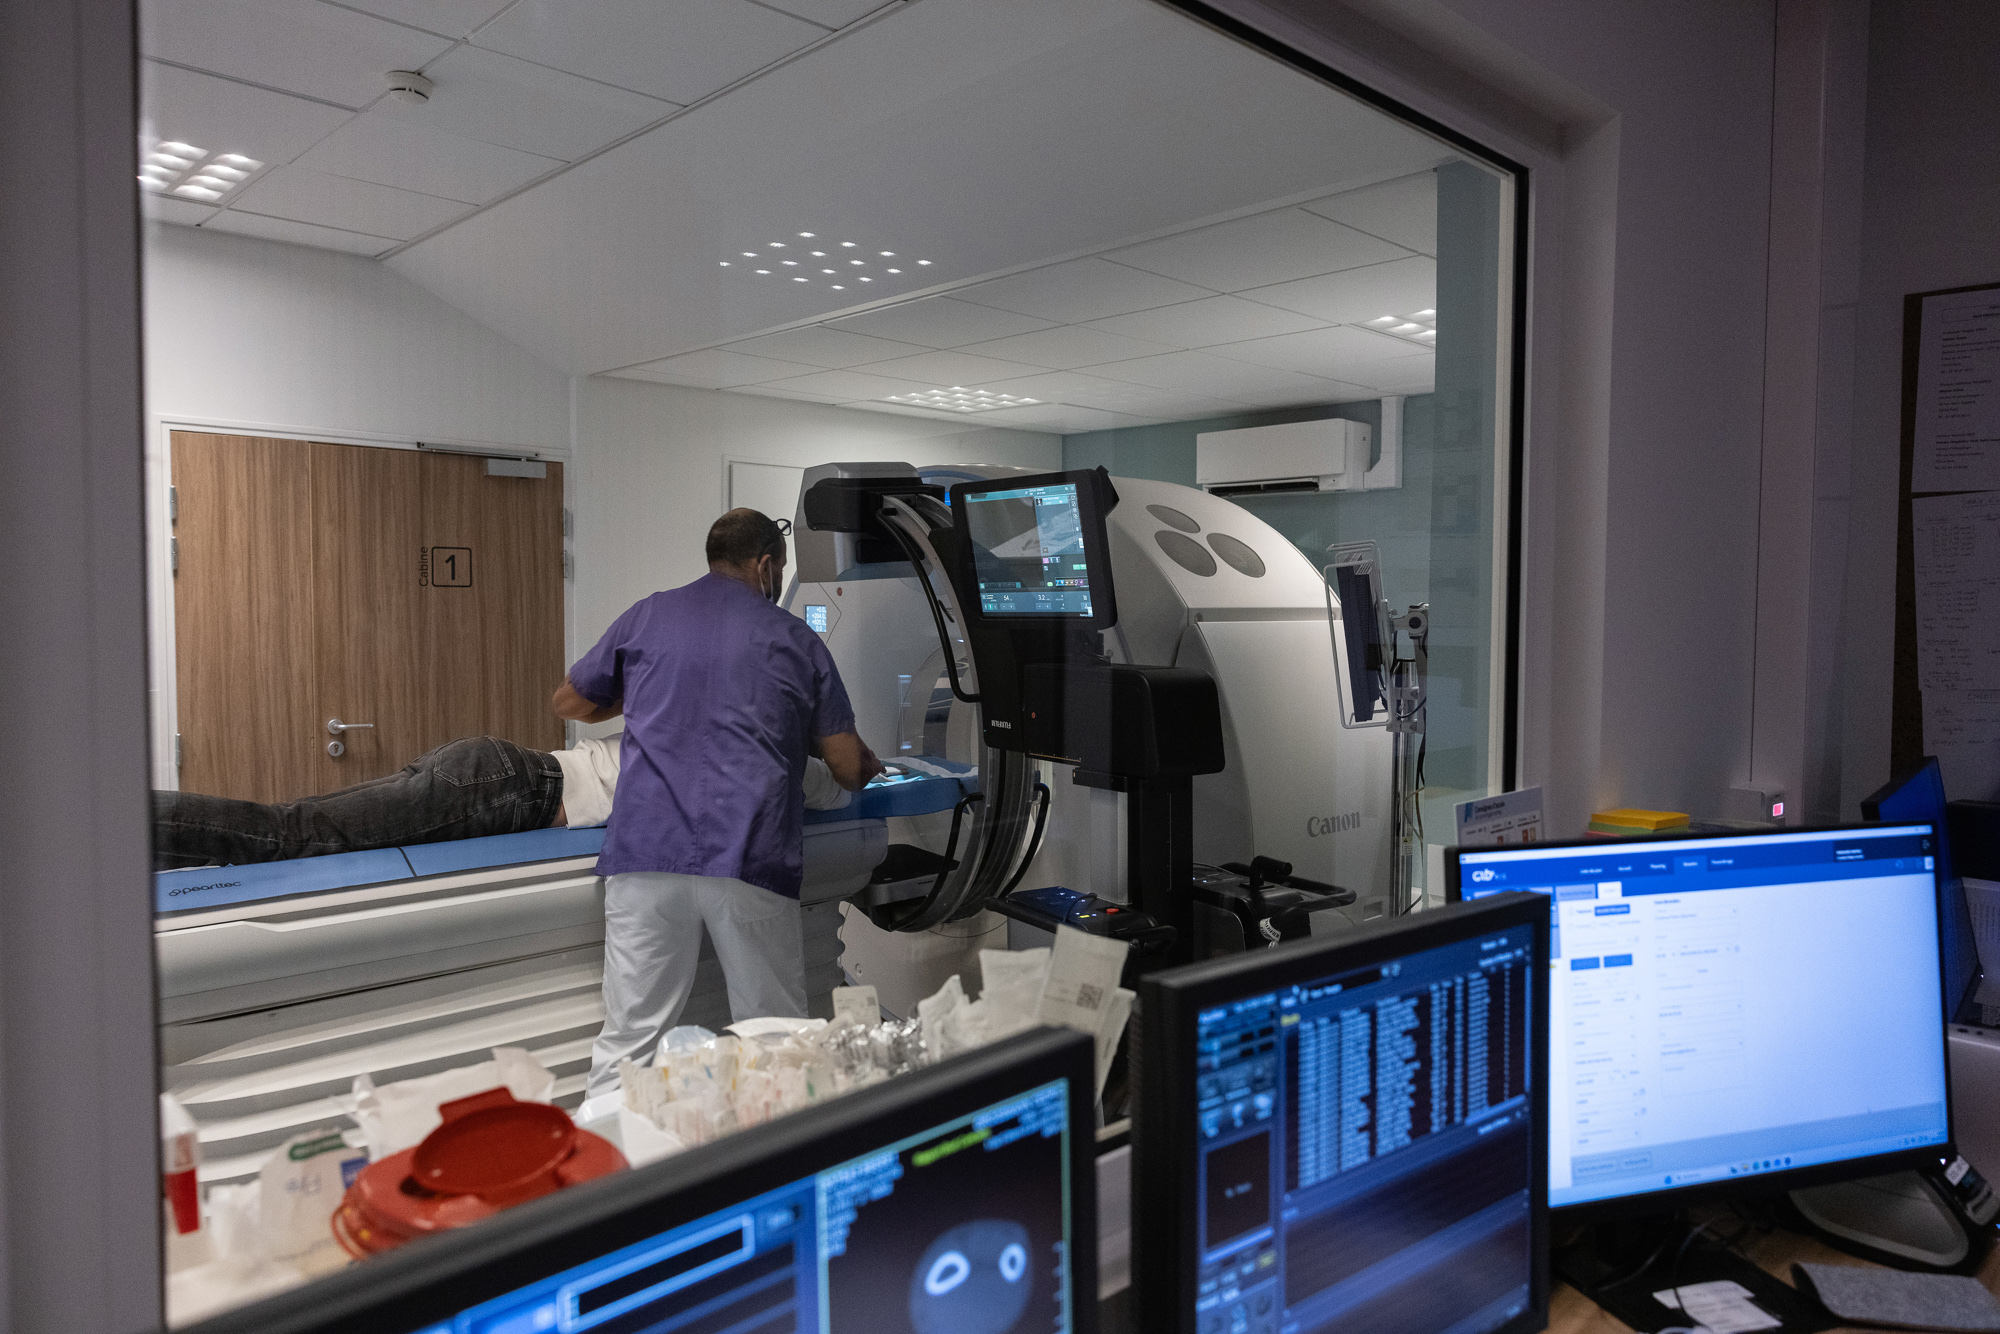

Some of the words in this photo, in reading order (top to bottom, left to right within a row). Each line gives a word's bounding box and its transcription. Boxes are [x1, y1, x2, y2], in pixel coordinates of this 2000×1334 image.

[418, 546, 429, 587] Cabine
[444, 554, 456, 581] 1
[991, 719, 1012, 730] FUJIFILM
[1306, 811, 1361, 838] Canon
[181, 881, 242, 895] pearltec
